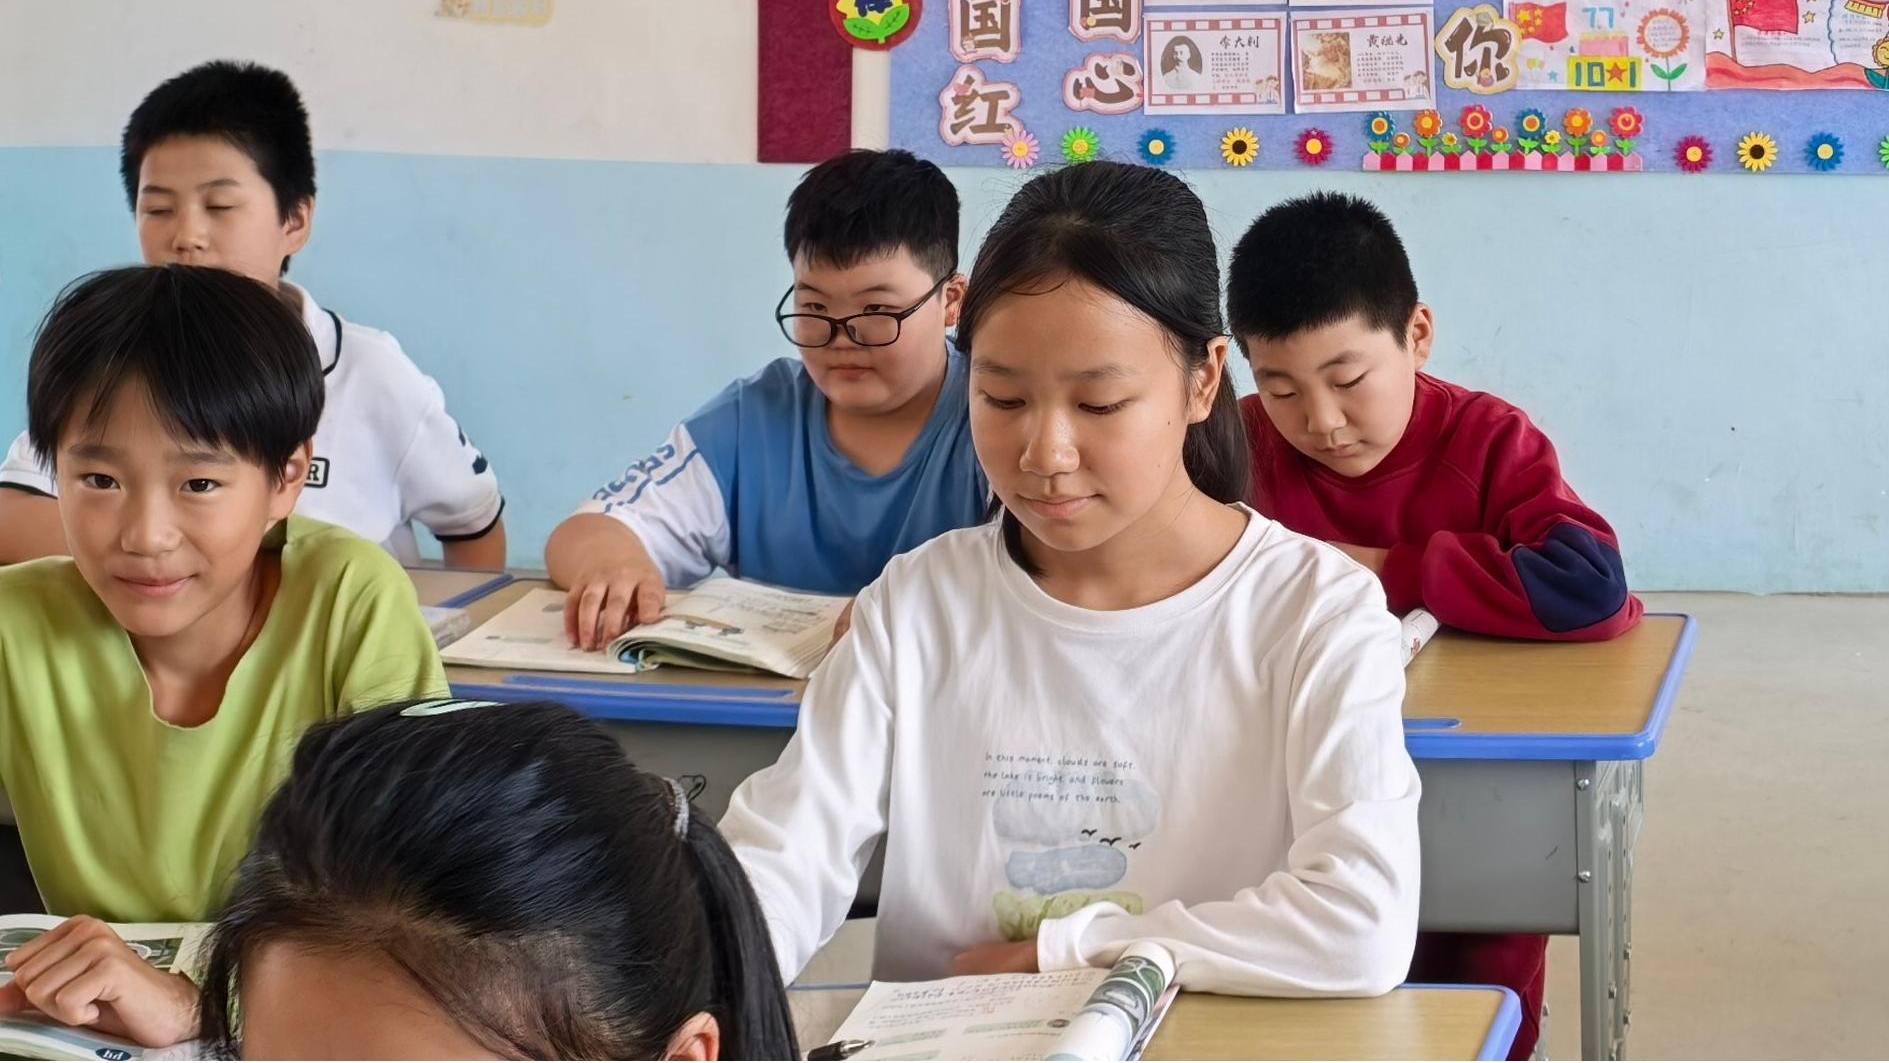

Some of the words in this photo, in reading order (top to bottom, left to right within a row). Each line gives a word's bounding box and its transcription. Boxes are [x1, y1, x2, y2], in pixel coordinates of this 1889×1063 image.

[1582, 6, 1615, 29] 77
[1057, 755, 1088, 767] clouds
[1092, 759, 1107, 769] are
[1068, 775, 1086, 785] and
[981, 788, 996, 798] are
[1027, 791, 1054, 804] poems
